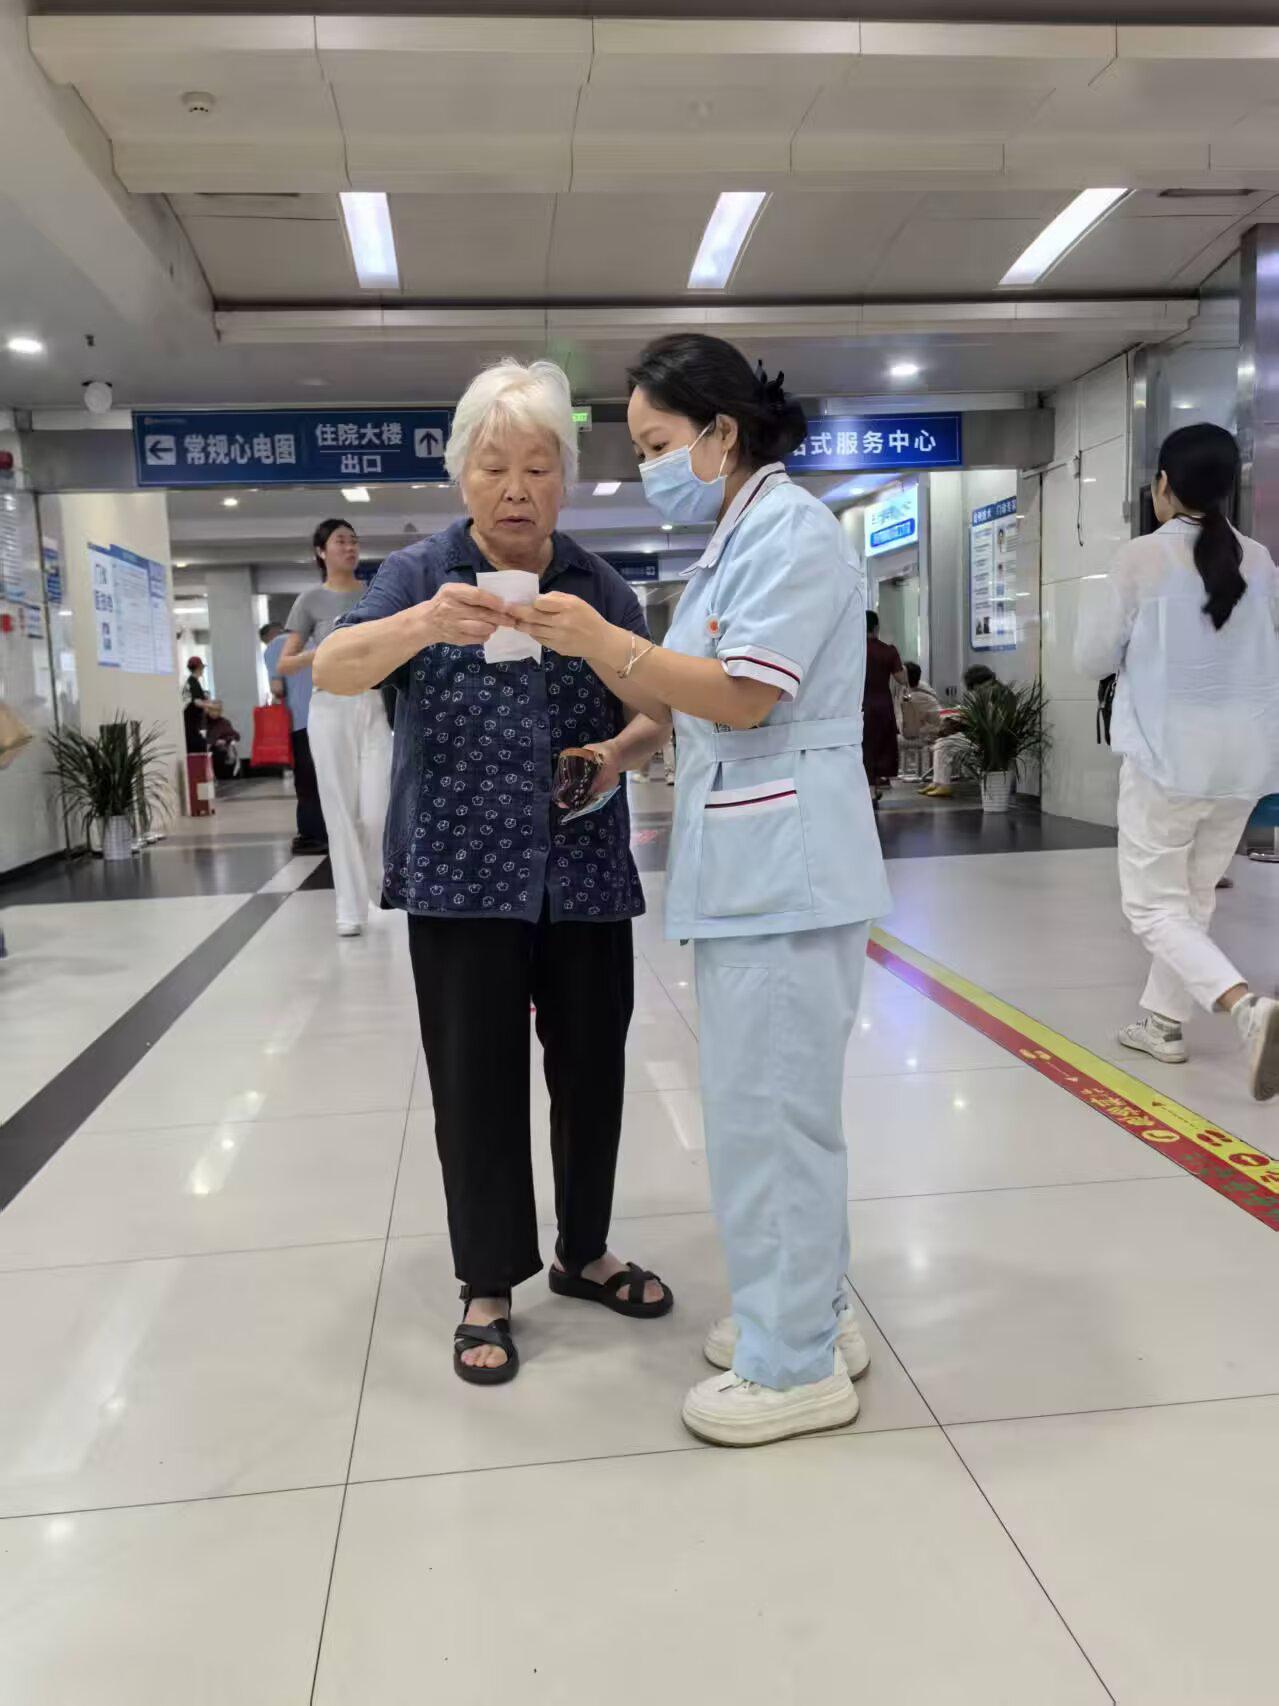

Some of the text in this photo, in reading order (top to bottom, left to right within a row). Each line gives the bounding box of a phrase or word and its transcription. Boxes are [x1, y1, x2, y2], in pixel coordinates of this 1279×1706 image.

[315, 423, 402, 446] 住院大楼
[183, 434, 296, 465] 常规心电图
[340, 454, 382, 474] 出口
